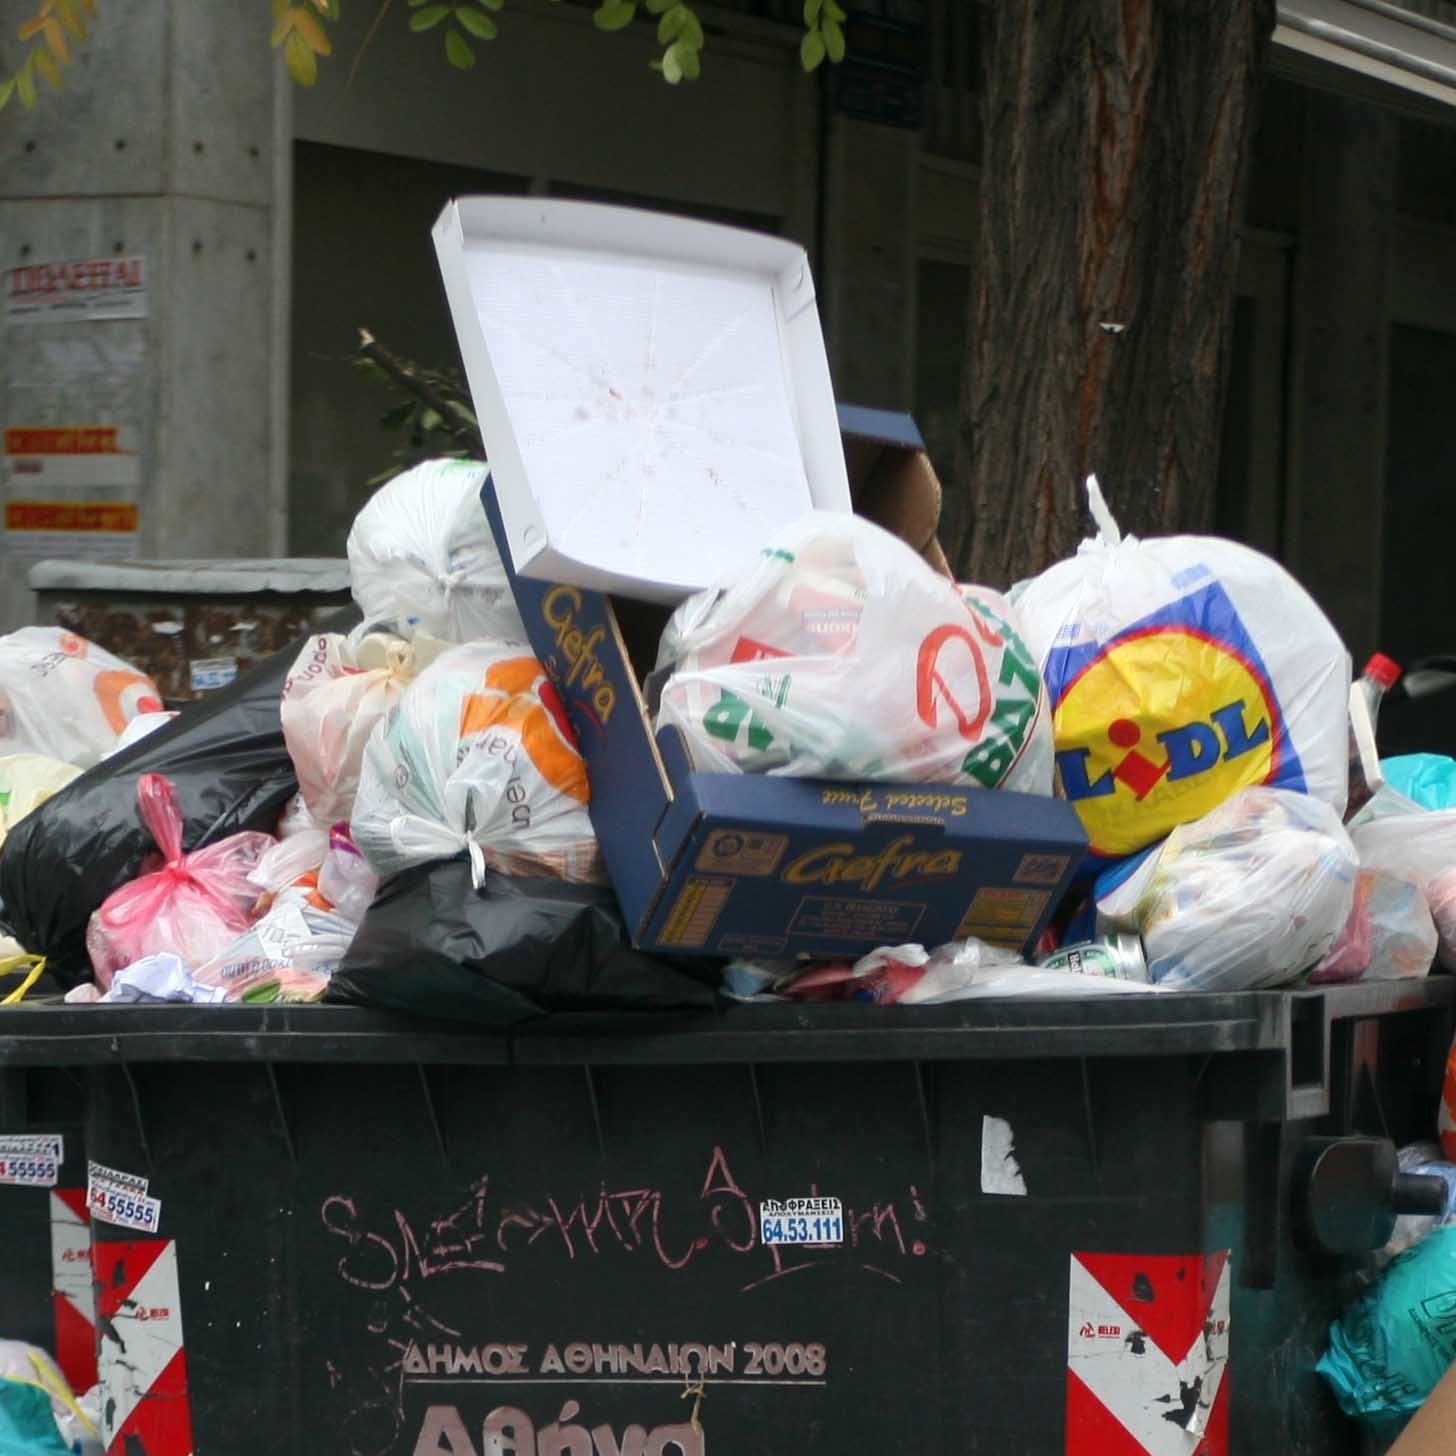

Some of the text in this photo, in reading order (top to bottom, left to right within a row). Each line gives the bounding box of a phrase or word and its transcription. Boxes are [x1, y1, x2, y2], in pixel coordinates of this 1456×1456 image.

[780, 834, 965, 893] Gefra
[763, 1217, 841, 1242] 64.53.111
[404, 1342, 827, 1376] ΔΗΜΟΣ ΑΘΗΝΑΙΩΝ 2008
